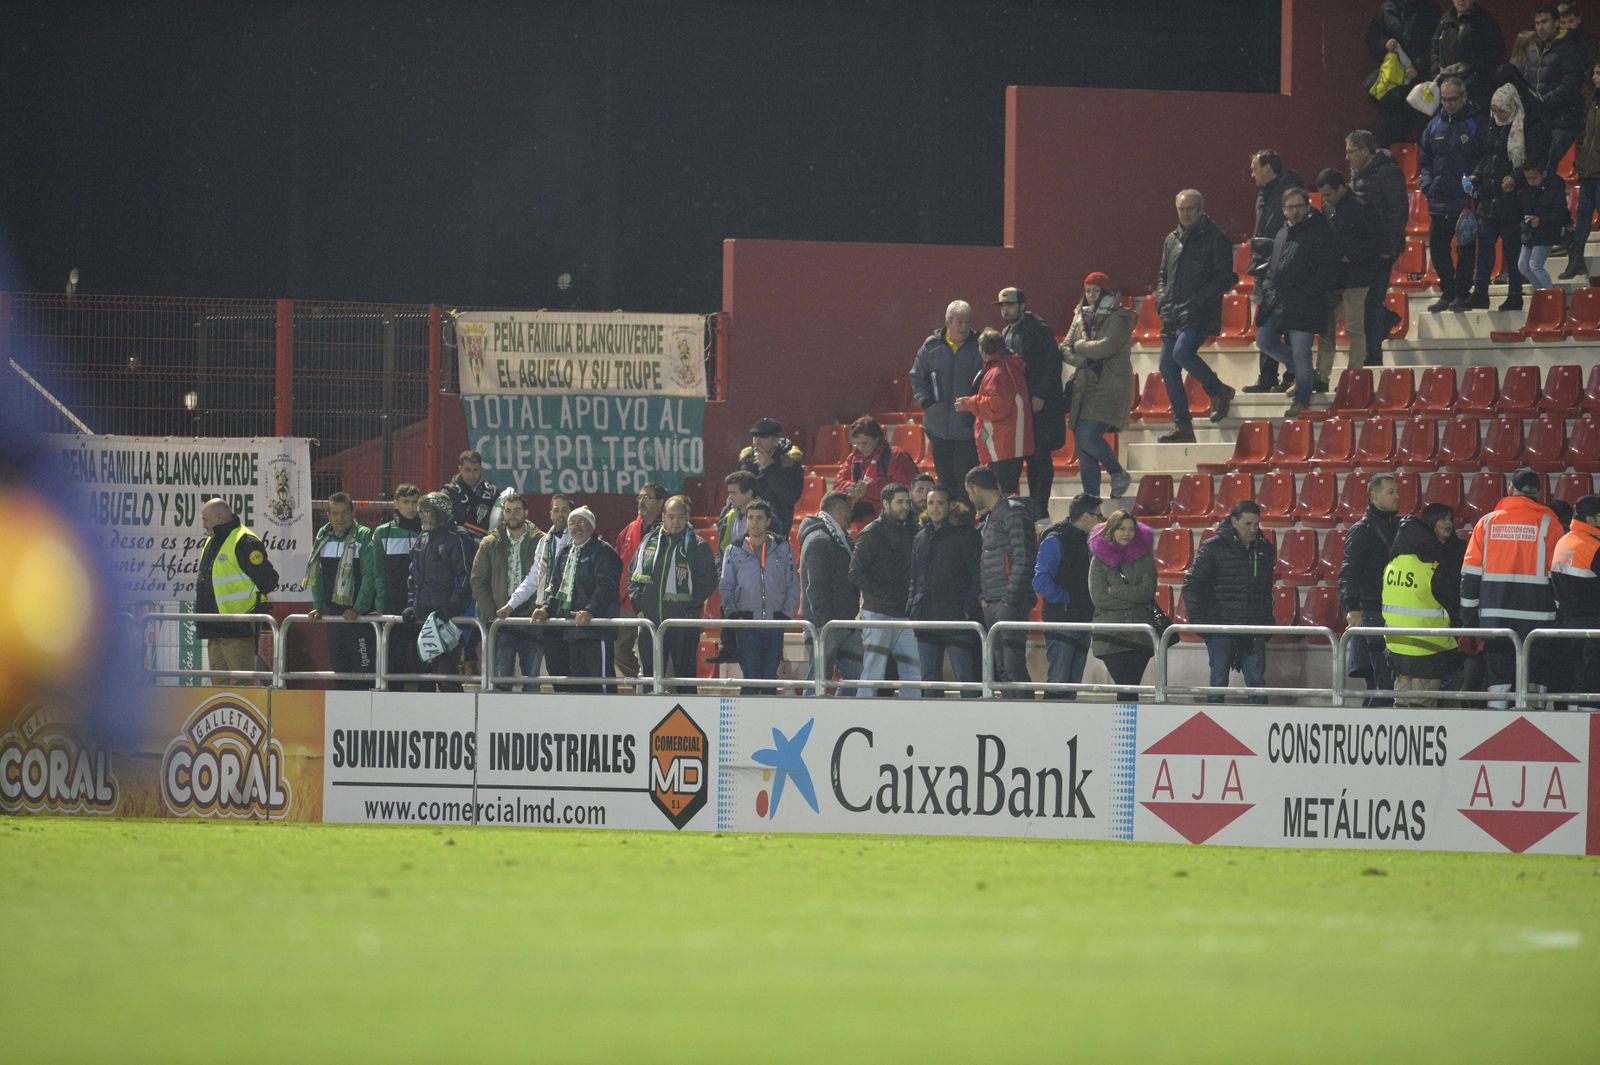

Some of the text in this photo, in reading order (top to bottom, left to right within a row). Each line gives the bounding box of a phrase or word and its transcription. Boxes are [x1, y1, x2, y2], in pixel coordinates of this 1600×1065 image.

[493, 316, 664, 355] PEÑA FAMILIA BLANQUIVERDE
[497, 359, 663, 390] EL ABUELO Y SU TRUPE
[464, 396, 552, 430] TOTAL
[660, 398, 691, 434] AL
[101, 450, 152, 485] FAMILIA
[156, 451, 259, 486] BLANQUIVERDE
[476, 435, 593, 471] CUERPO
[513, 470, 527, 495] Y
[158, 492, 169, 527] Y
[174, 493, 196, 528] SU
[161, 537, 177, 549] es
[148, 552, 199, 580] Afici
[1386, 569, 1418, 588] C.I.S.
[194, 708, 260, 739] GALLETAS
[332, 729, 636, 774] SUMINISTROS INDUSTRIALES
[654, 734, 701, 753] COMERCIAL
[1267, 722, 1448, 767] CONSTRUCCIONES
[0, 747, 113, 801] CORAL
[168, 749, 285, 806] CORAL
[651, 757, 703, 793] MD
[830, 726, 1096, 819] CaixaBank
[364, 796, 607, 825] www.comercialmd.com
[1283, 788, 1427, 842] METÁLICAS
